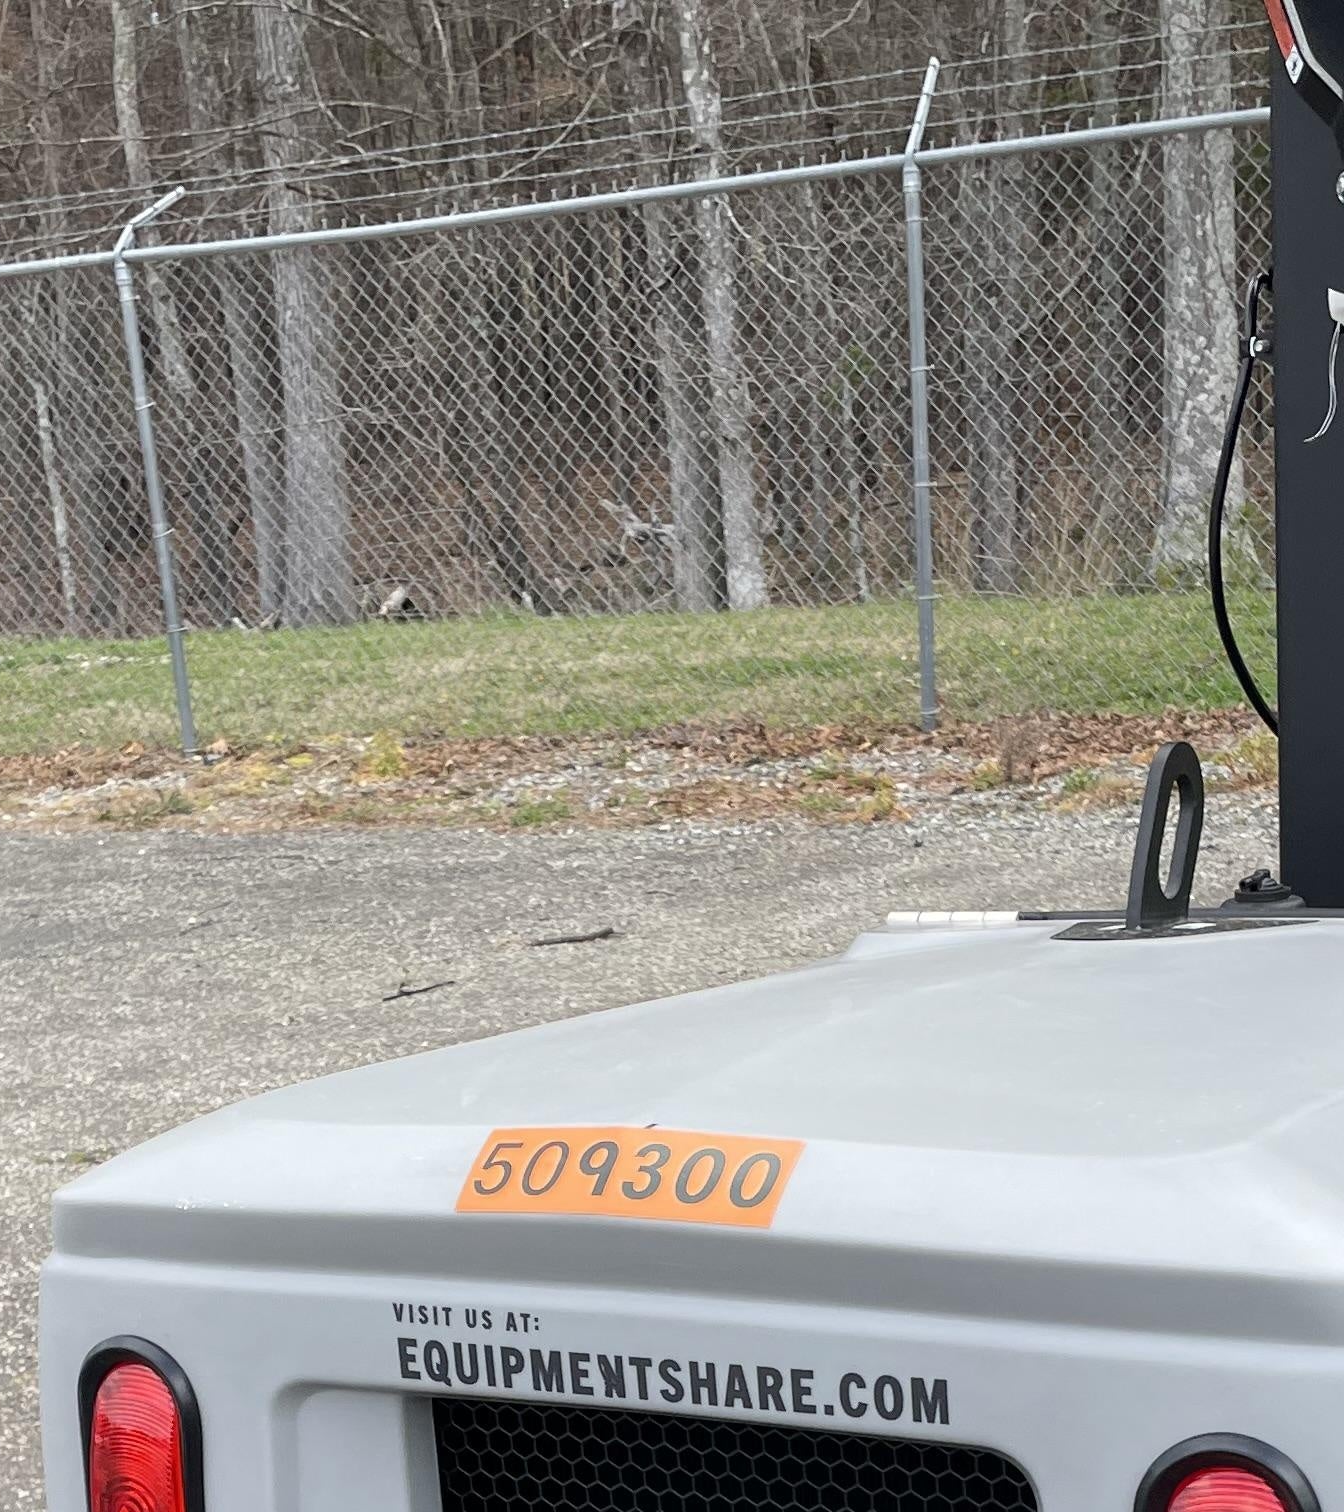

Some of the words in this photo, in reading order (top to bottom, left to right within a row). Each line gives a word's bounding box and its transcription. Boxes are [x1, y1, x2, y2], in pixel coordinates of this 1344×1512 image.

[472, 1140, 784, 1209] 509300
[392, 1302, 452, 1327] VISIT
[465, 1307, 494, 1330] US
[505, 1311, 541, 1333] AT:
[396, 1336, 950, 1425] EQUIPMENTSHARE.COM
